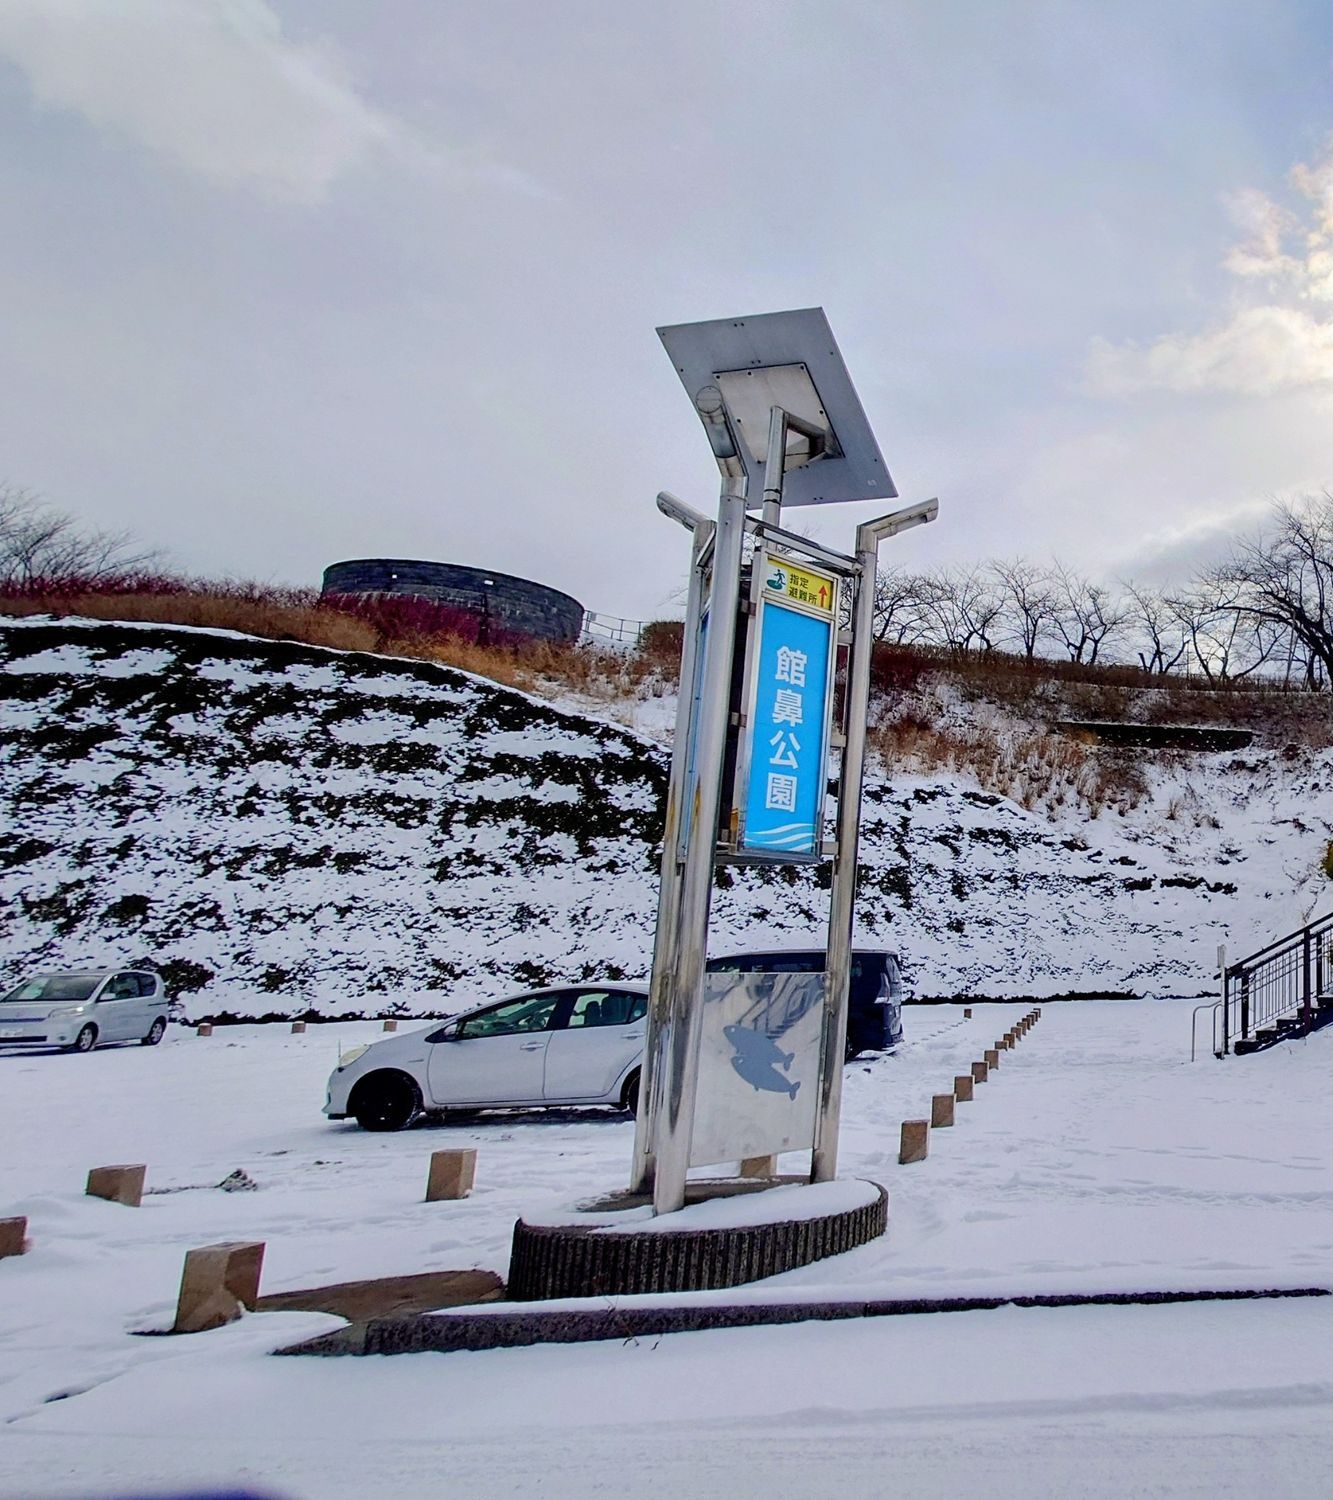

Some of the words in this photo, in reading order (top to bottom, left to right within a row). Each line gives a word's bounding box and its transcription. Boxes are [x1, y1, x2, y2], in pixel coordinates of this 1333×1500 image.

[789, 573, 809, 589] 指定
[788, 586, 818, 606] 避難所
[765, 645, 808, 813] 館鼻公園
